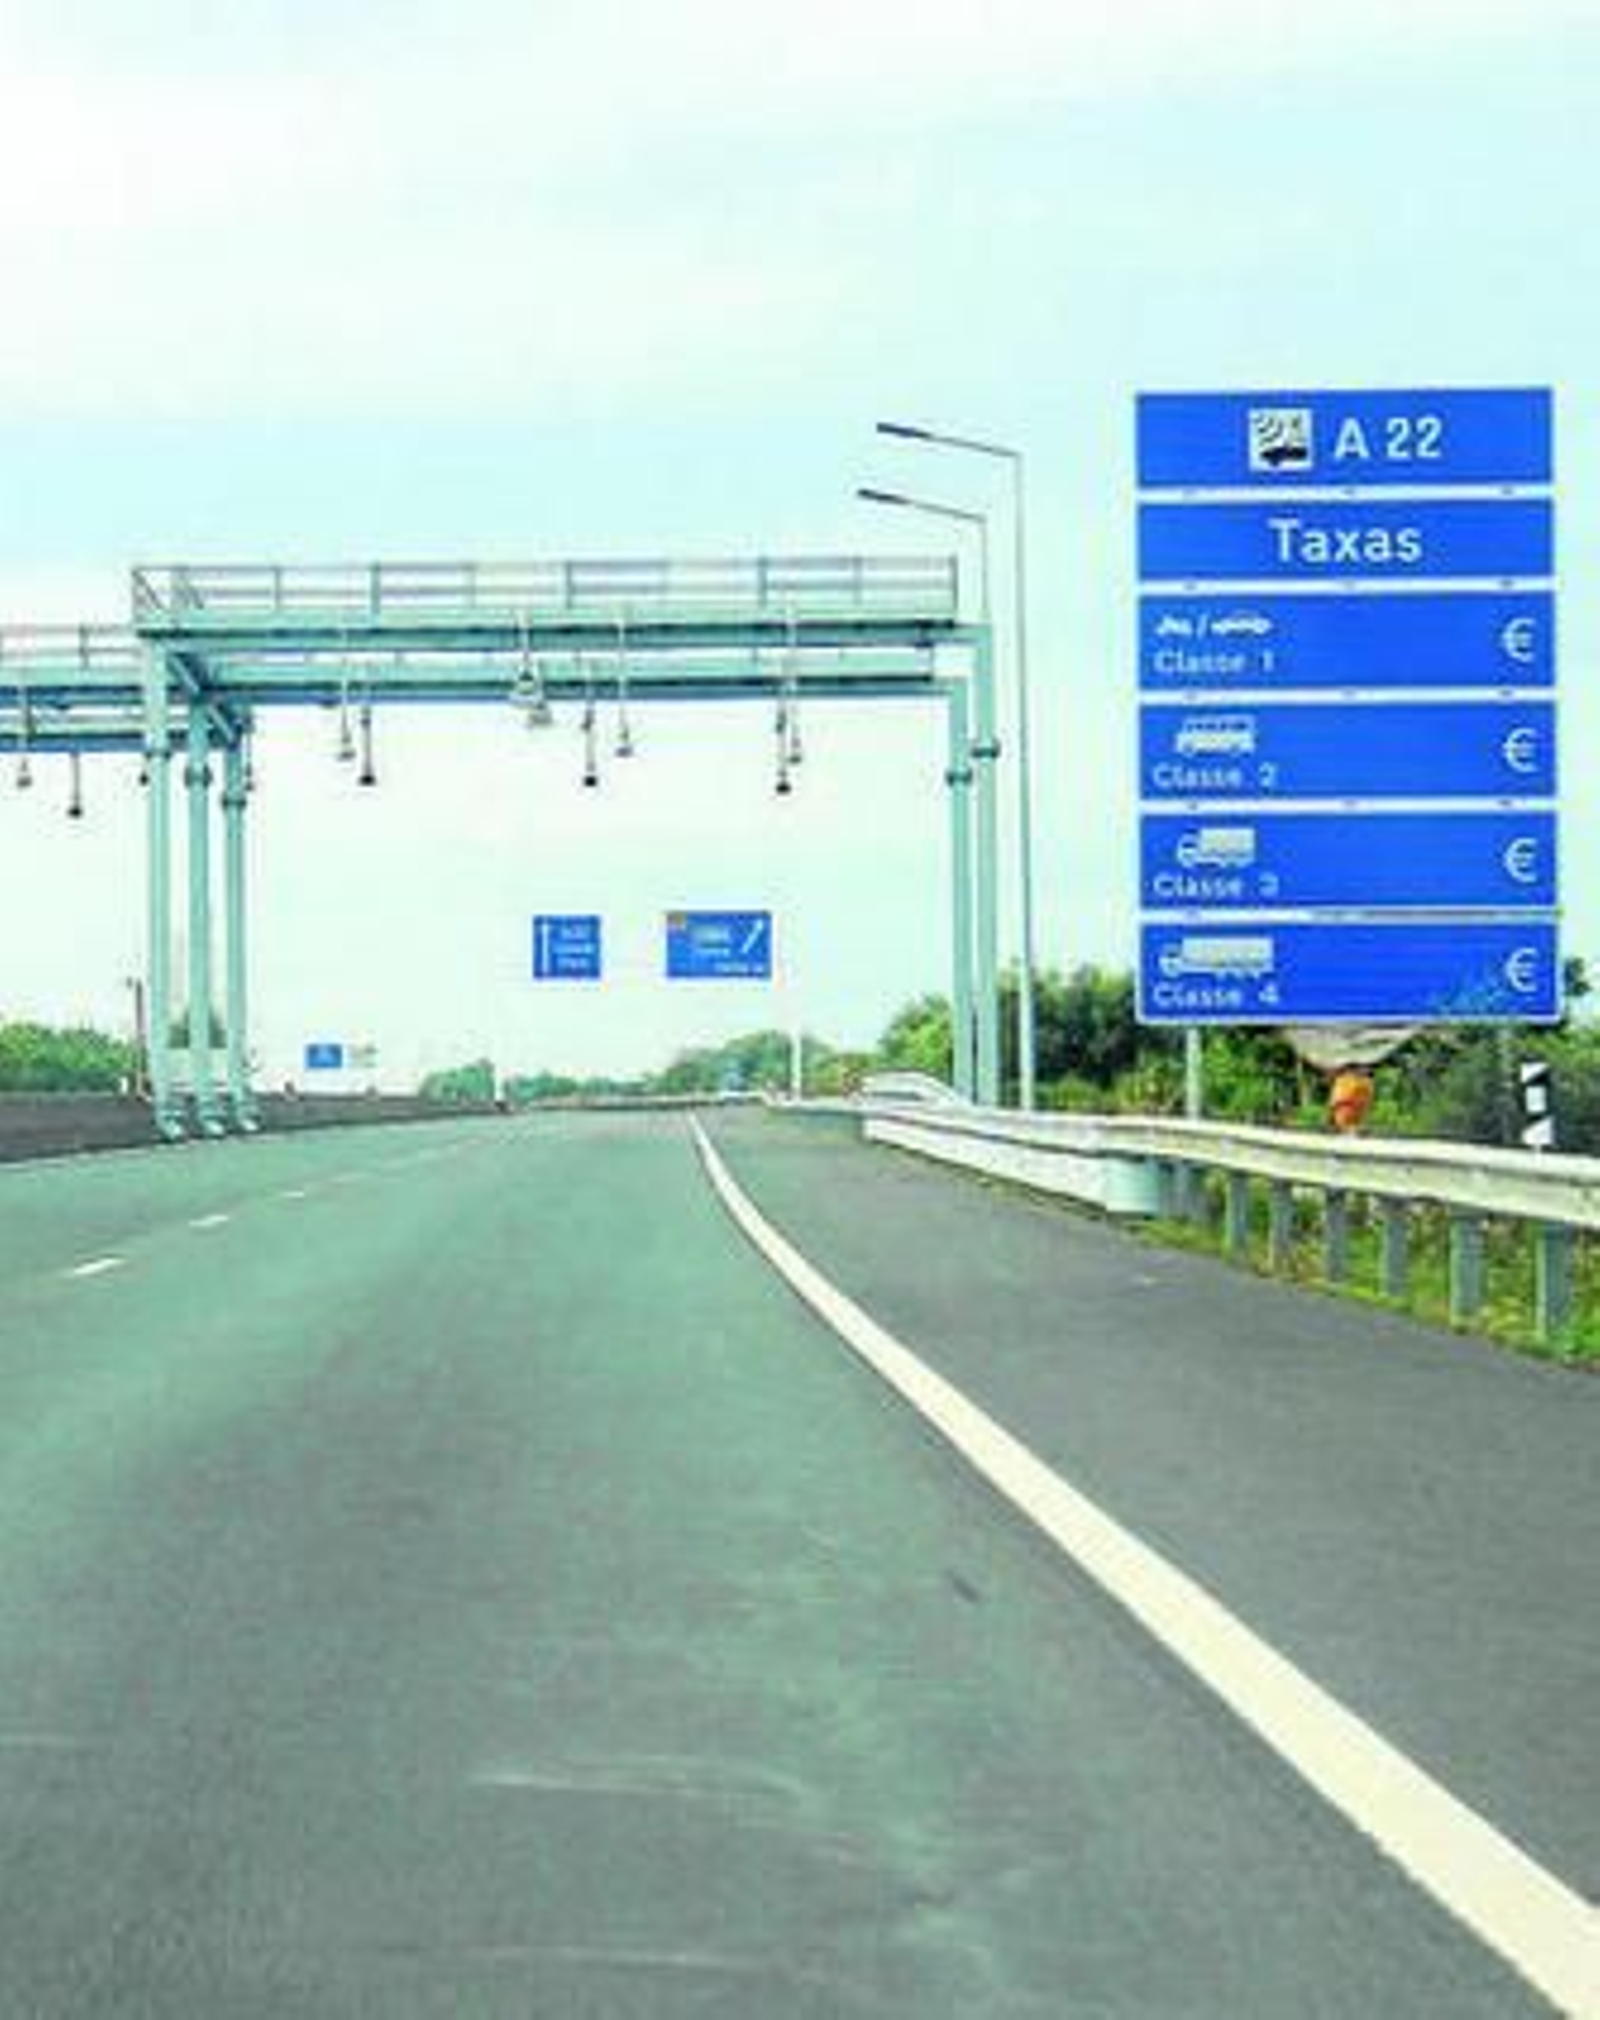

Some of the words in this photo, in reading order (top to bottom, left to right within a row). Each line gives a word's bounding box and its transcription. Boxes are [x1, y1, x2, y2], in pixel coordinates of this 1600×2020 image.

[1334, 418, 1369, 459] A
[1387, 416, 1441, 459] 22
[1269, 519, 1421, 562] Taxas
[1502, 618, 1535, 662] €
[1154, 650, 1245, 675] Classe
[1261, 650, 1275, 672] 1
[1502, 728, 1536, 772] €
[1153, 763, 1242, 788] Classe
[1259, 762, 1277, 787] 2
[1504, 838, 1536, 882] €
[1153, 873, 1243, 898] Classe
[1504, 948, 1537, 992] €
[1153, 982, 1243, 1007] Classe
[1259, 982, 1279, 1004] 4
